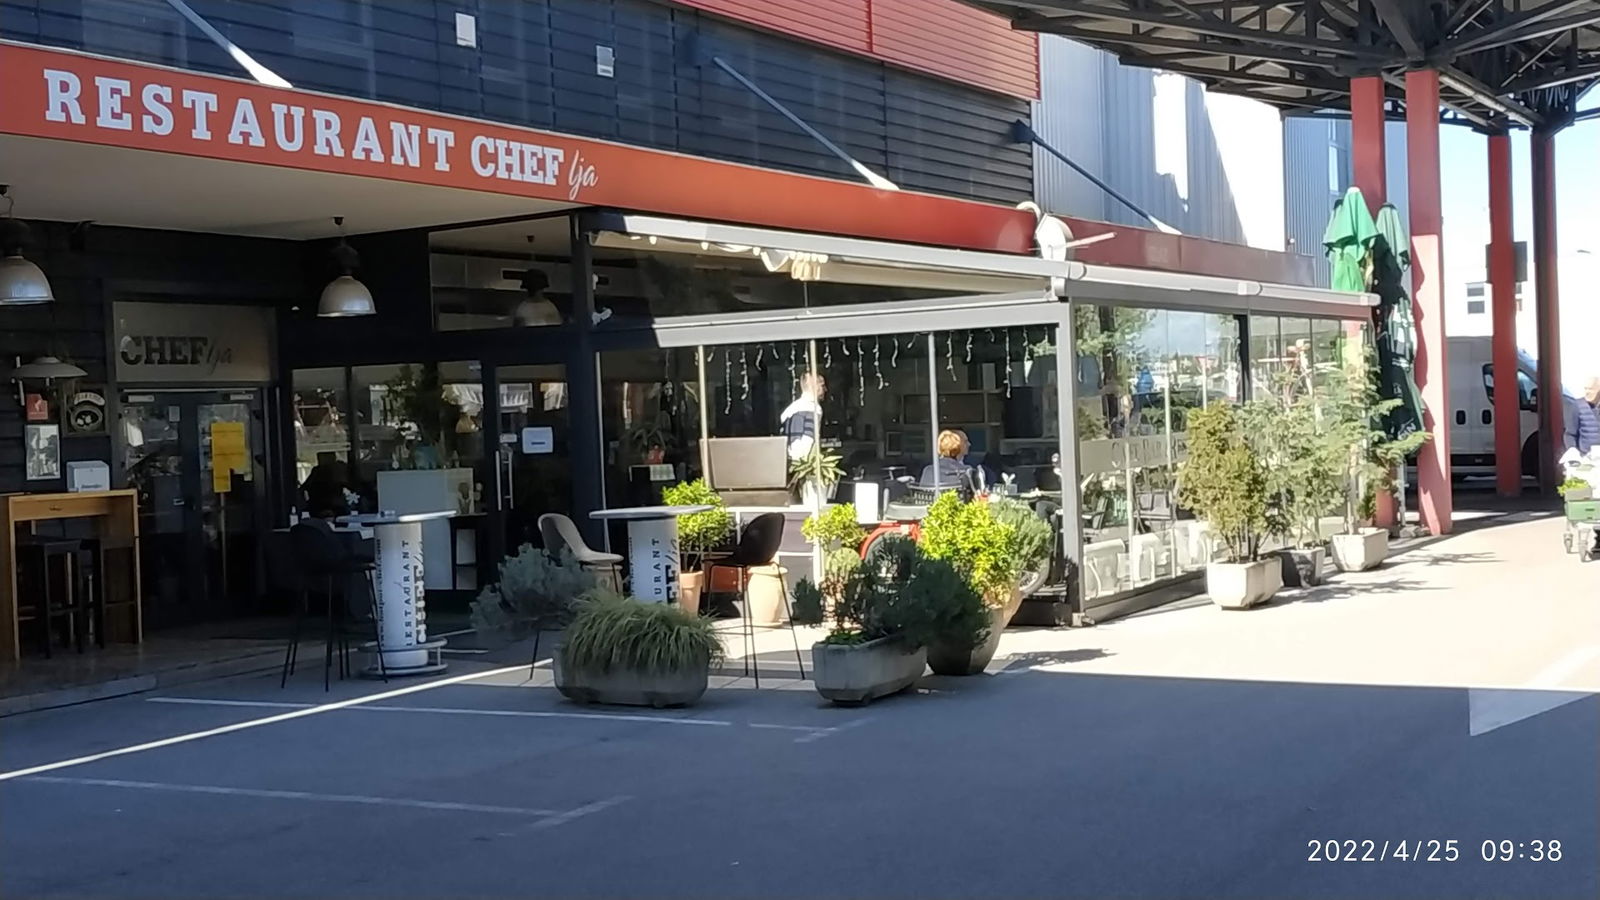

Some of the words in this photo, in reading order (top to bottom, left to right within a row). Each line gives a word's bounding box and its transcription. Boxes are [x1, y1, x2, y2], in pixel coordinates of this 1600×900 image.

[43, 68, 455, 173] RESTAURANT
[470, 134, 565, 187] CHEF
[567, 149, 599, 202] lja
[119, 334, 208, 366] CHEF
[652, 539, 662, 603] URANT
